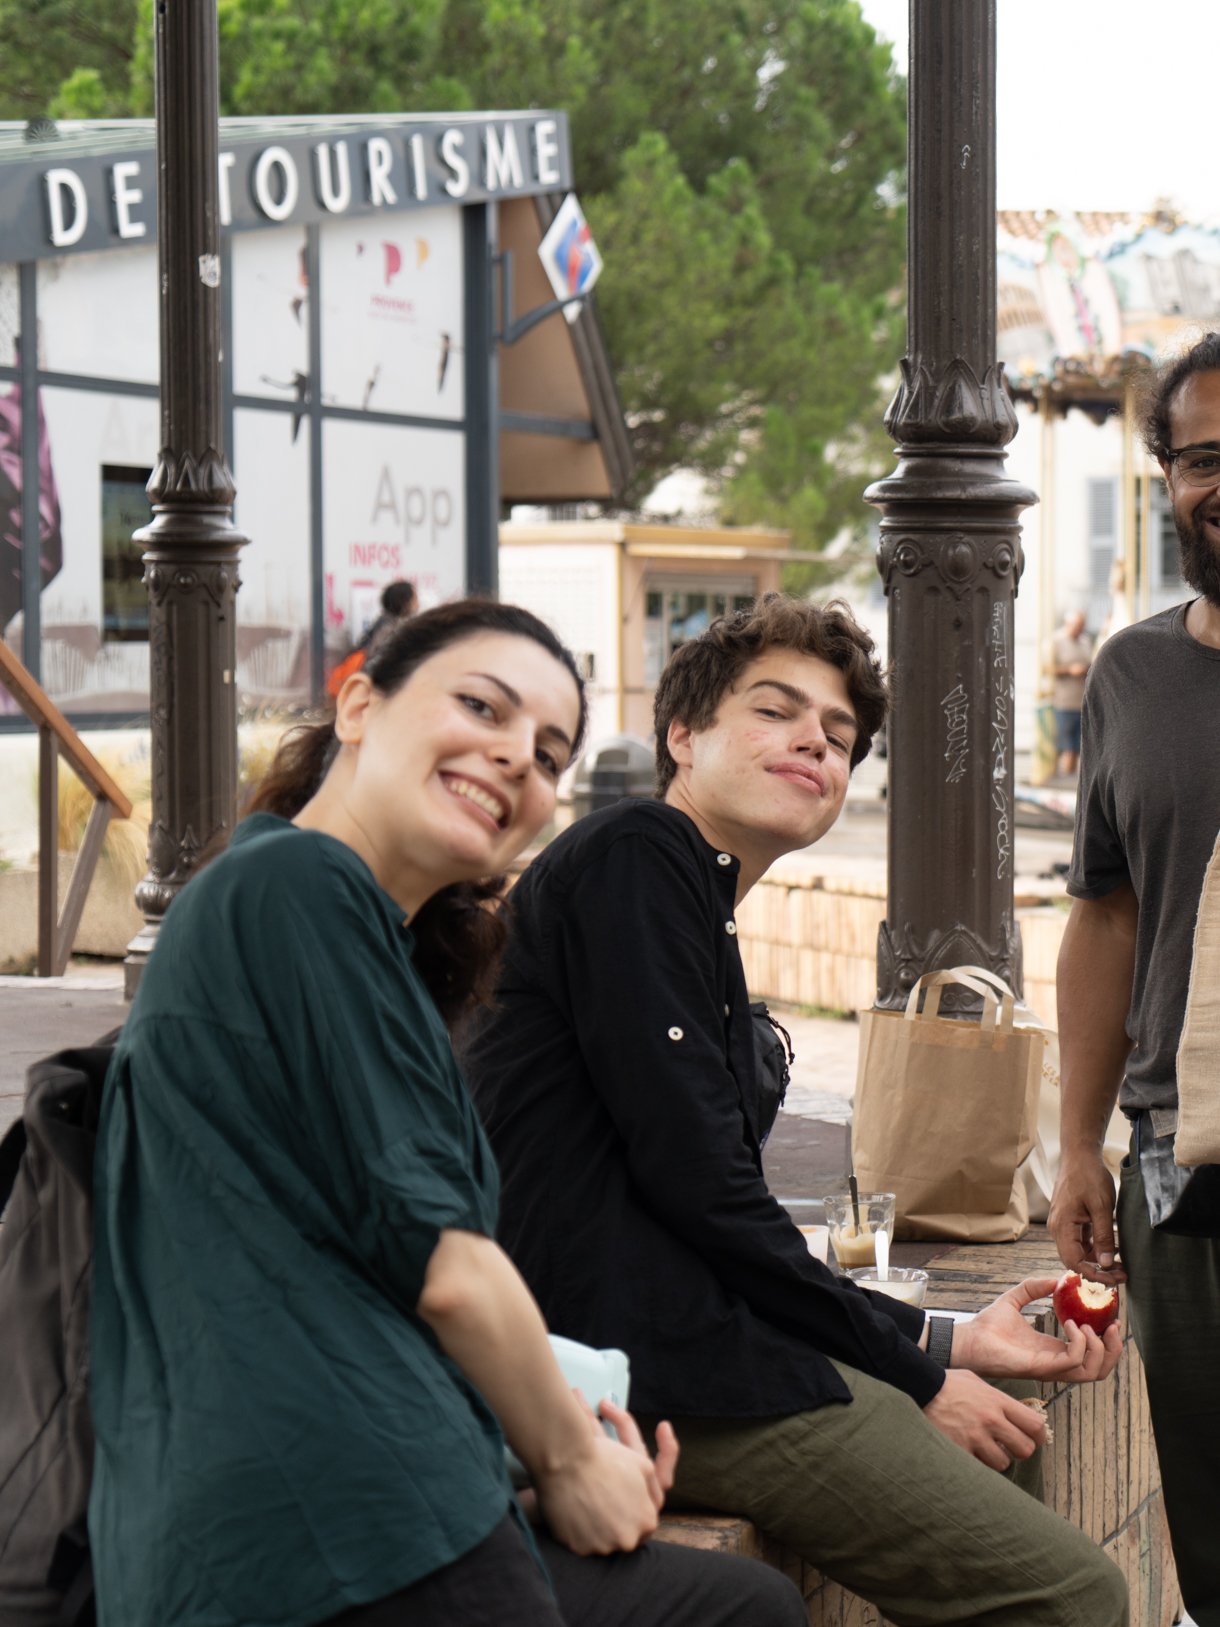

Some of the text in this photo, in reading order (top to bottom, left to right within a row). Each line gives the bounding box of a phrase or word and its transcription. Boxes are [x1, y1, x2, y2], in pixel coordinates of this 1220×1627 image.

[45, 119, 561, 248] DE TOURISME
[370, 463, 453, 548] App
[349, 542, 401, 568] INFOS
